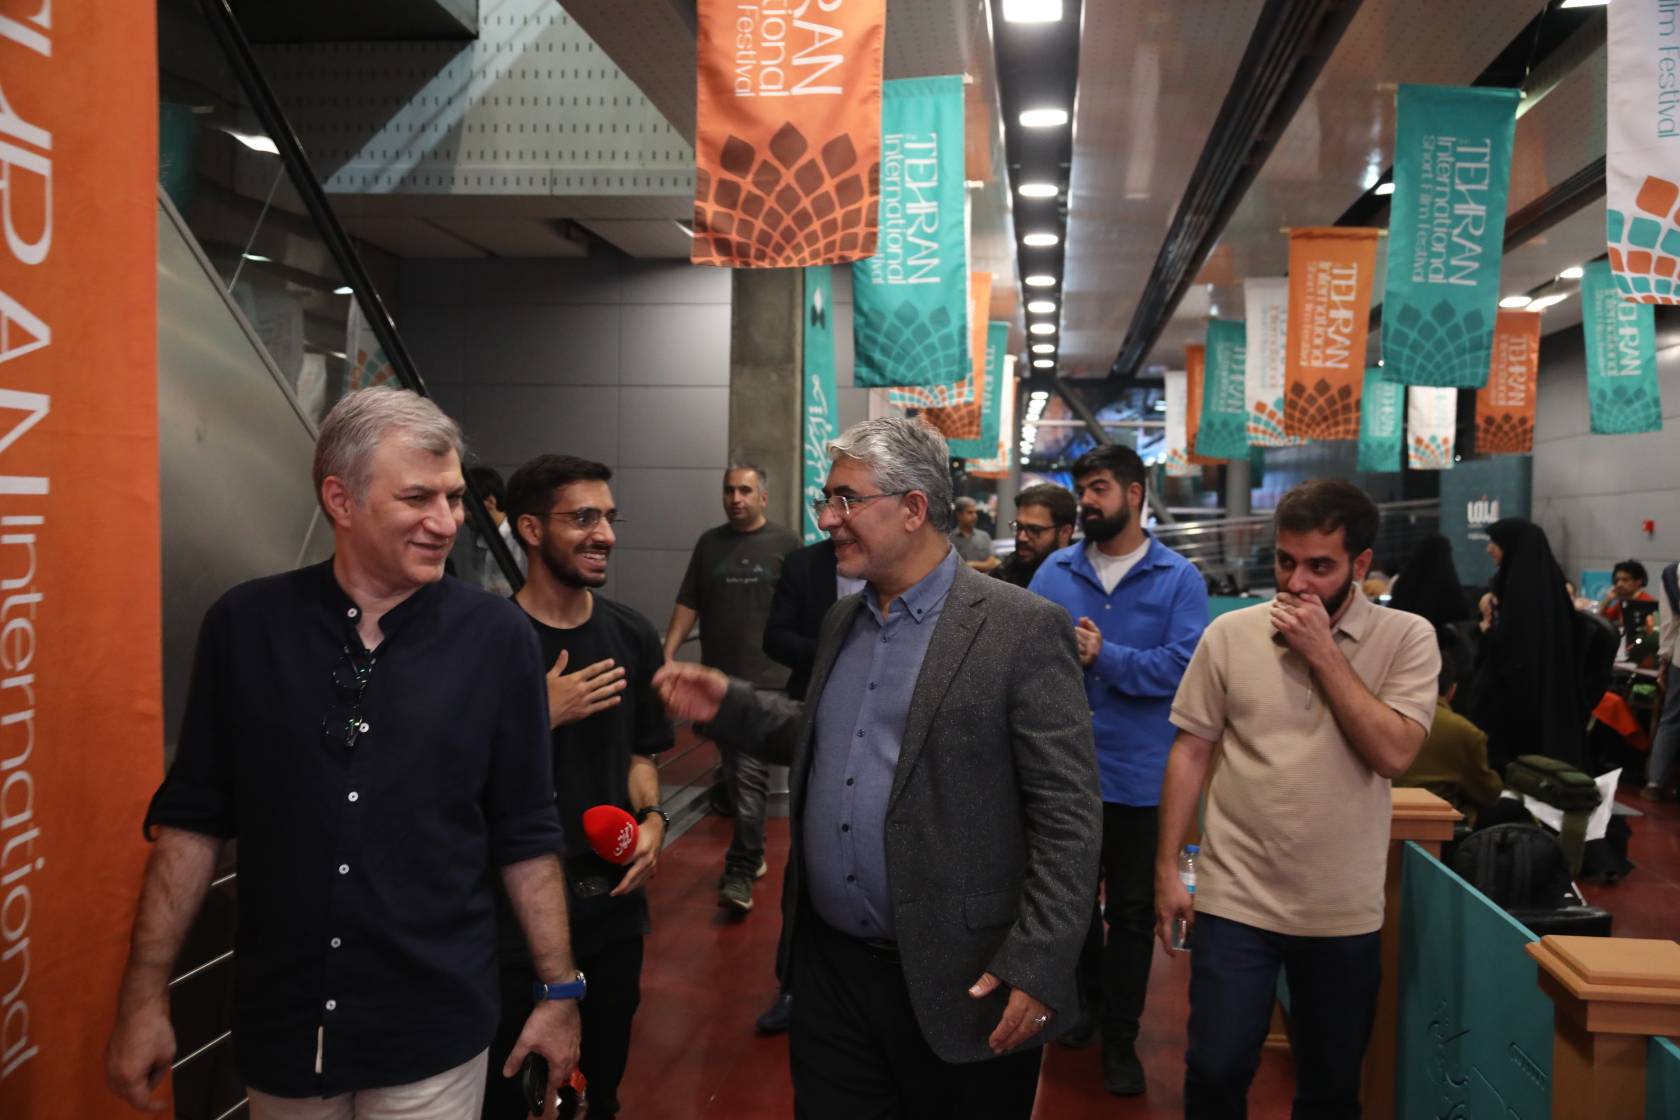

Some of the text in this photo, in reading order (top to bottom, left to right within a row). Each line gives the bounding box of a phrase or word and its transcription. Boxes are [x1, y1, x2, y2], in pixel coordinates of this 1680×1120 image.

[734, 5, 759, 97] Festival
[884, 134, 907, 285] International
[904, 132, 941, 285] TEHRAN
[1412, 135, 1436, 283] Short Film Festival
[1428, 136, 1457, 284] International
[1448, 138, 1491, 286] TEHRAN
[1327, 262, 1358, 369] TEHRAN
[1618, 303, 1642, 376] EHRAN
[0, 514, 45, 1079] International
